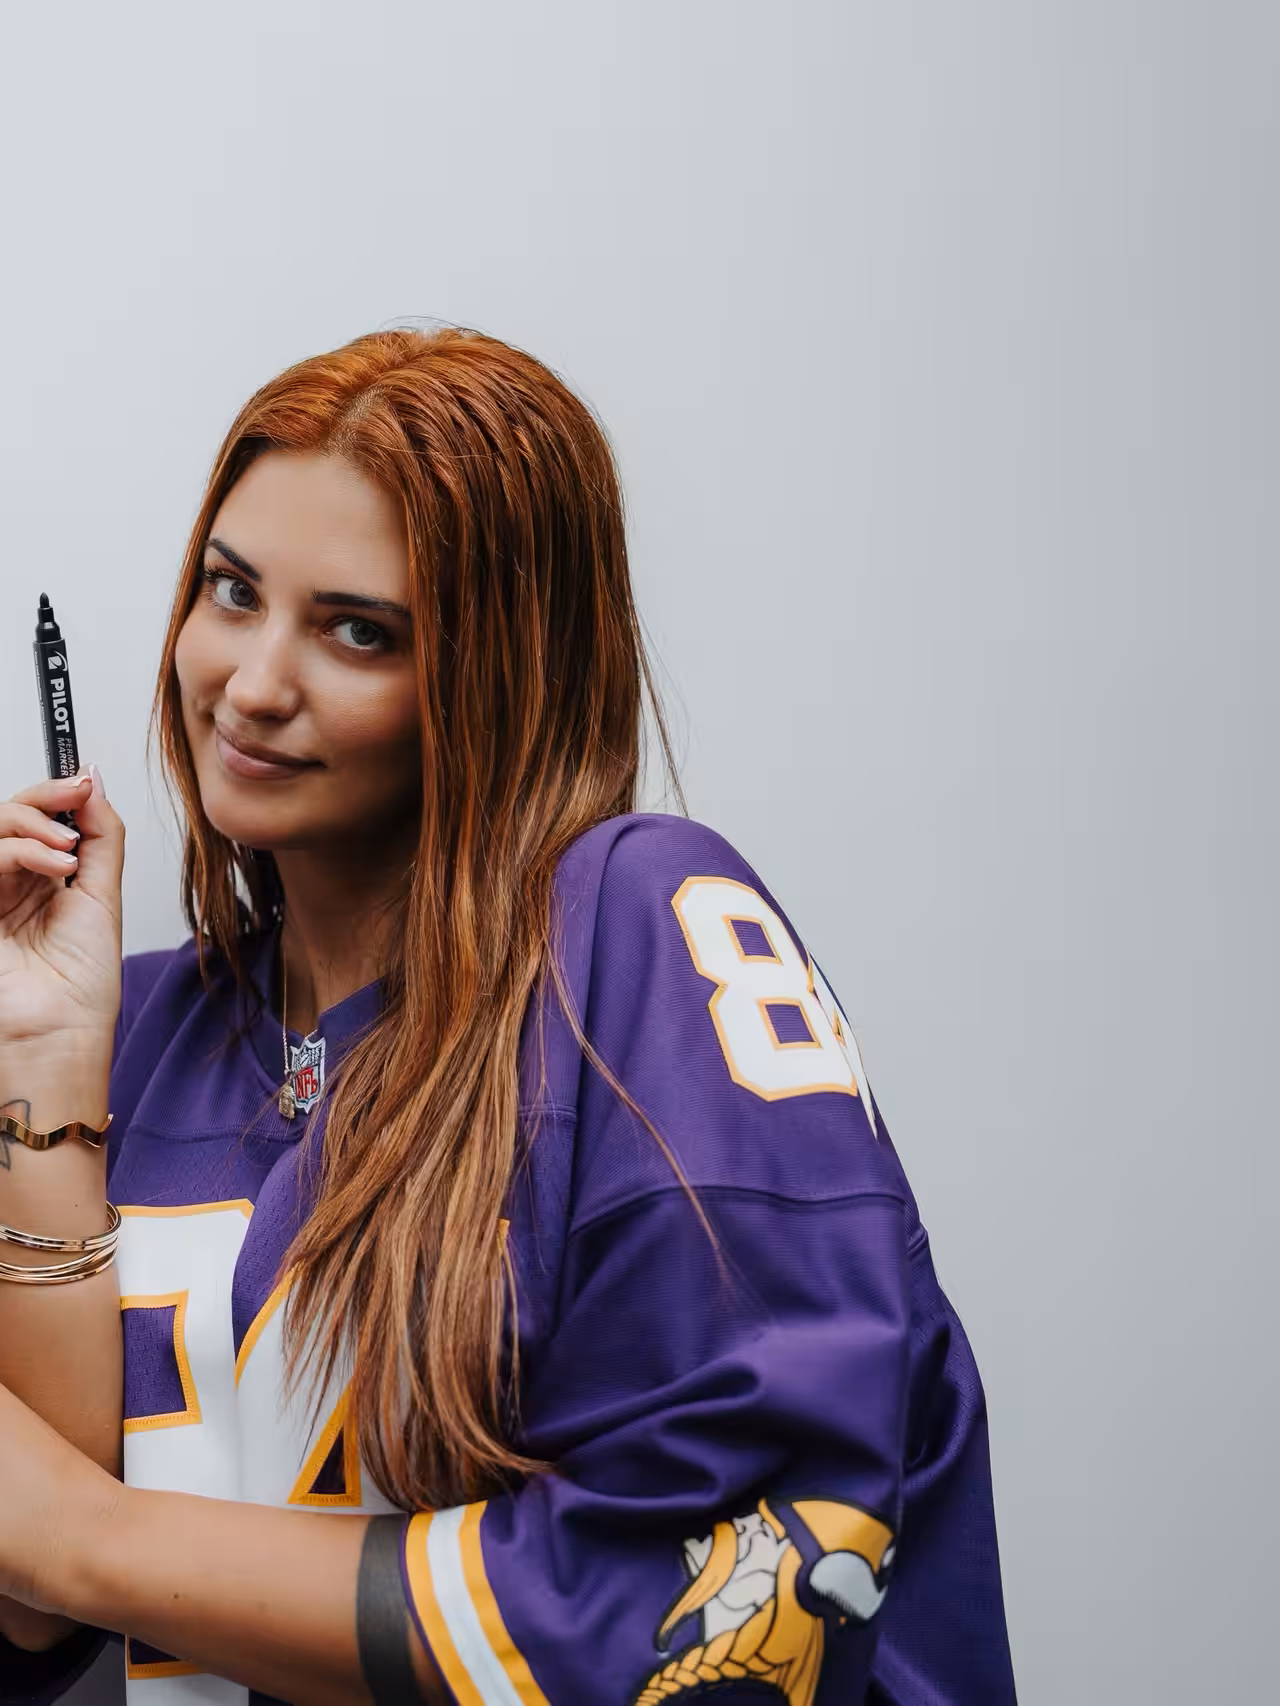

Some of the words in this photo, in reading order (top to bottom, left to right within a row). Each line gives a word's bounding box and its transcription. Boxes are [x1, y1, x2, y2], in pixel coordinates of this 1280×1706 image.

[50, 677, 70, 733] PILOT
[57, 737, 69, 776] MARKER
[65, 737, 76, 777] PERMAN
[296, 1069, 318, 1099] NFL
